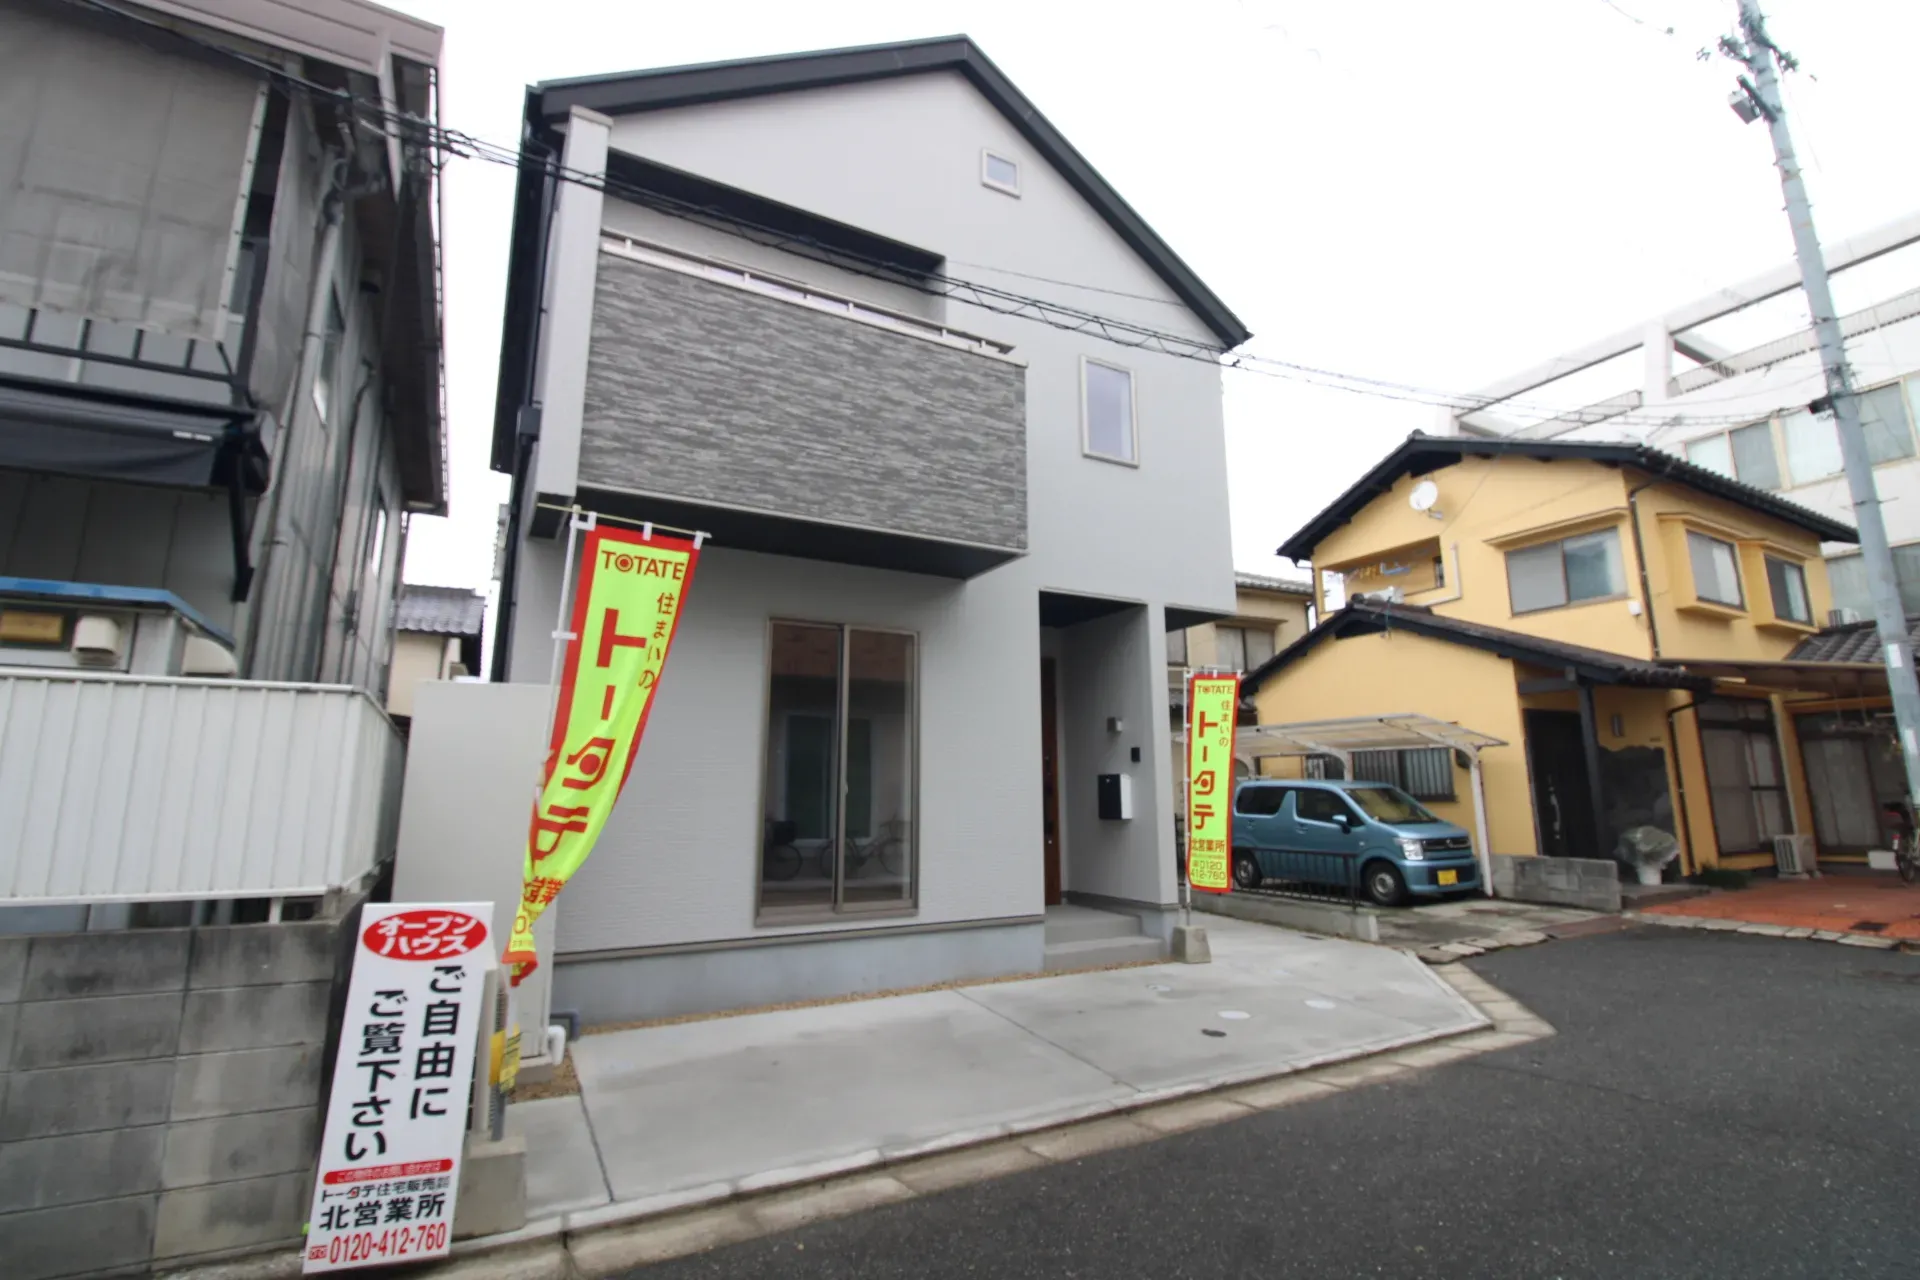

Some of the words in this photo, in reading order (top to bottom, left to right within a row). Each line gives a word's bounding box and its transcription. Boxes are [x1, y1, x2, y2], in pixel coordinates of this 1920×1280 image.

[601, 550, 686, 581] TOTATE
[638, 591, 675, 690] 住まいの
[1197, 685, 1234, 694] TOTATE
[532, 607, 647, 863] トータテ
[1219, 700, 1232, 747] 住まいの
[1194, 711, 1218, 830] トータテ
[377, 915, 478, 937] オープン
[379, 935, 469, 956] ハウス
[409, 965, 467, 1120] ご自由に
[344, 989, 408, 1162] ご覧下さい
[319, 1193, 446, 1231] 北営業所
[330, 1222, 446, 1264] 0120-412-760
